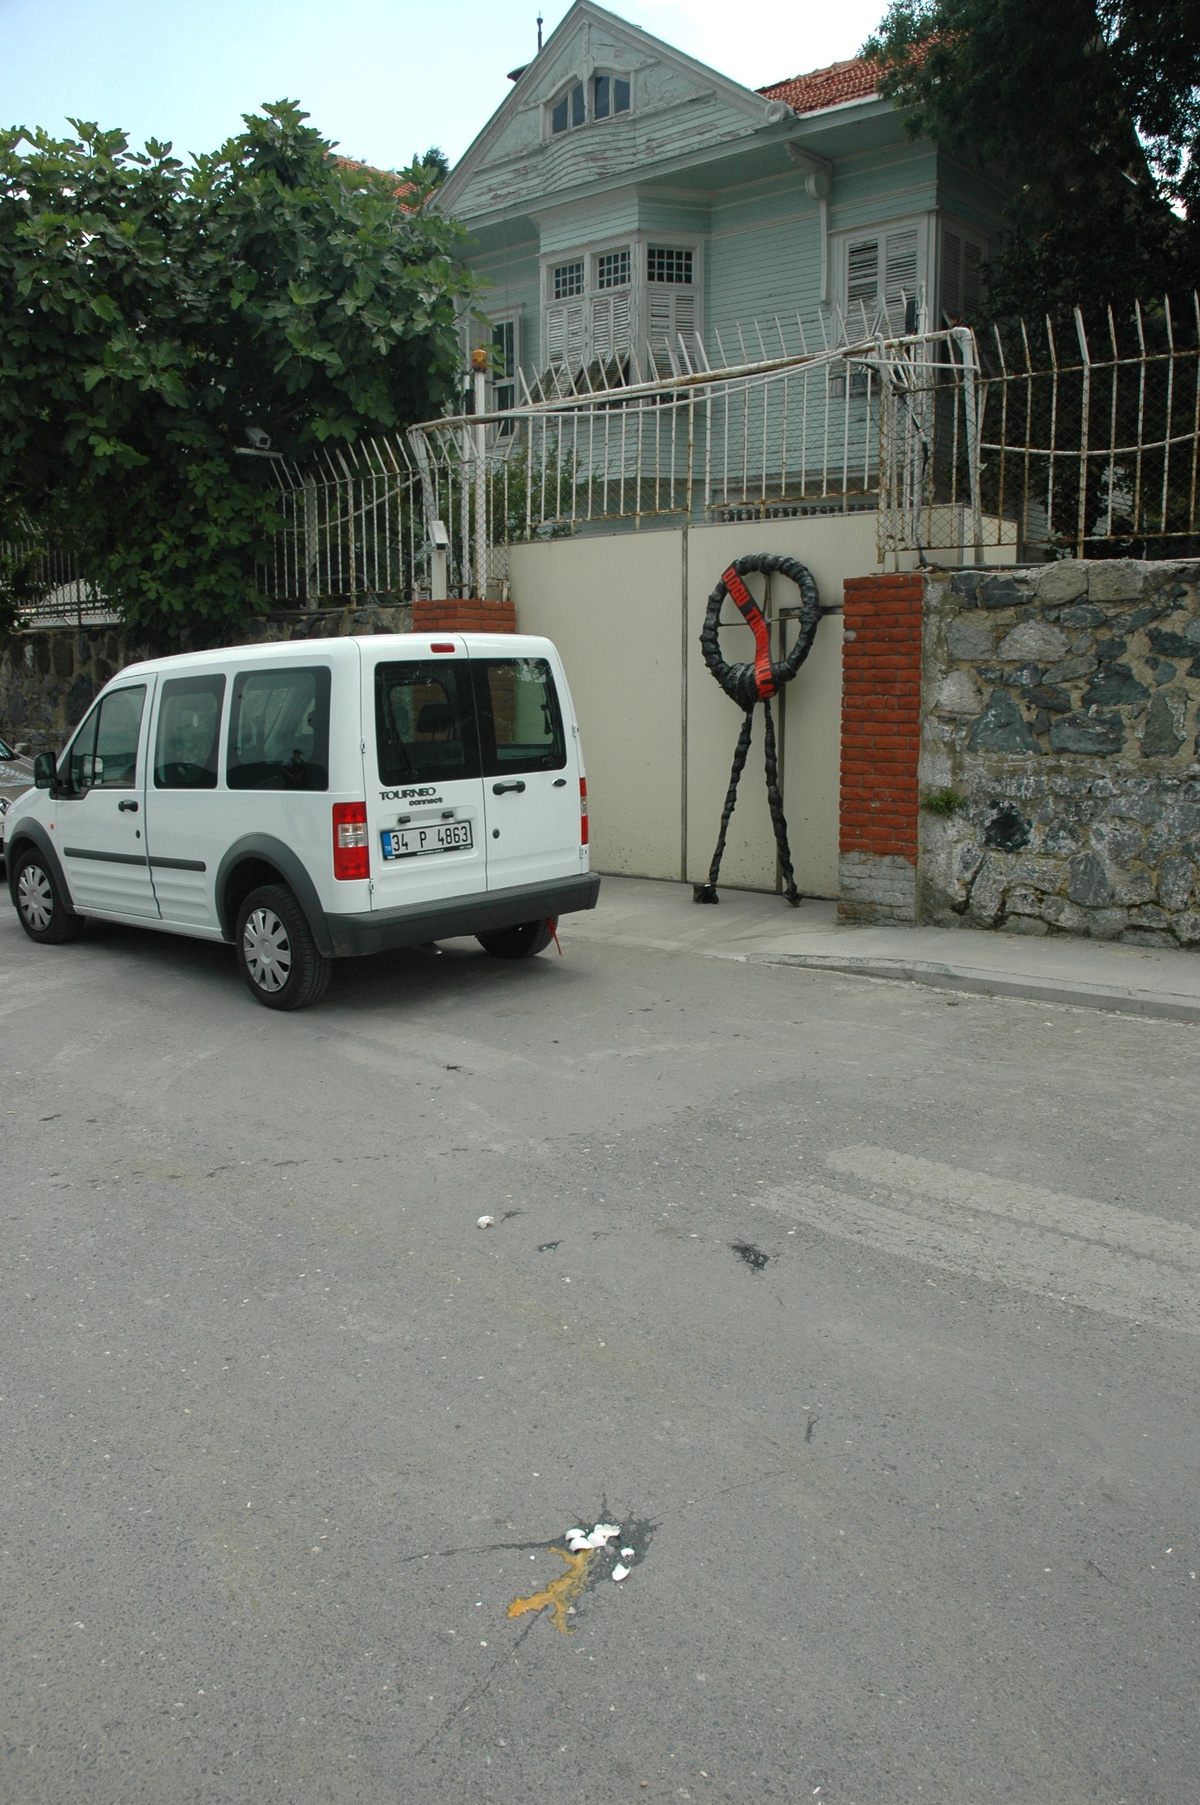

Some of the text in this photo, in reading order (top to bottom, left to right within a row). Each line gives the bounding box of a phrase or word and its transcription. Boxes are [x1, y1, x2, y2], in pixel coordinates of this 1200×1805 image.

[379, 787, 436, 801] TOURNEO
[409, 796, 443, 806] connect
[392, 826, 469, 851] 34 P 4863
